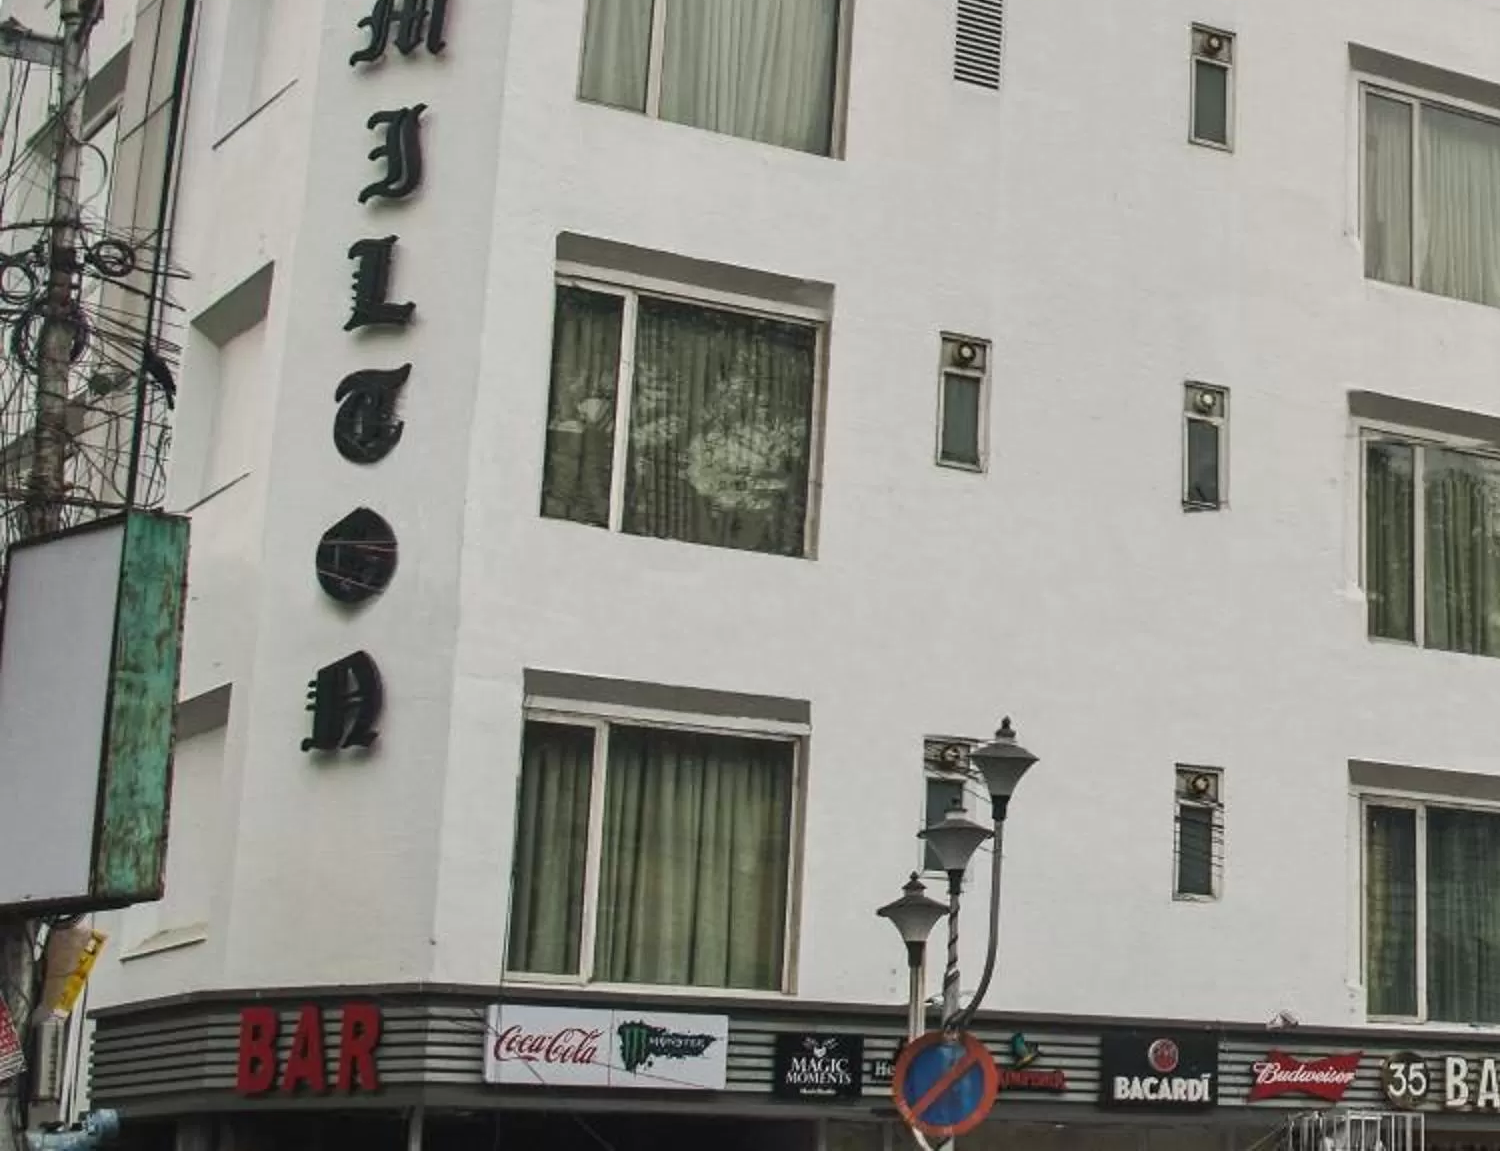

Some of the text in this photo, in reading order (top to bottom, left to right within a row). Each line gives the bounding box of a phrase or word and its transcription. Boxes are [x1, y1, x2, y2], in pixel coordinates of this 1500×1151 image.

[236, 1003, 382, 1095] BAR
[791, 1056, 849, 1072] MAGIC
[1253, 1062, 1355, 1085] Budweiser
[785, 1071, 852, 1085] MOMENTS
[1389, 1062, 1427, 1096] 35
